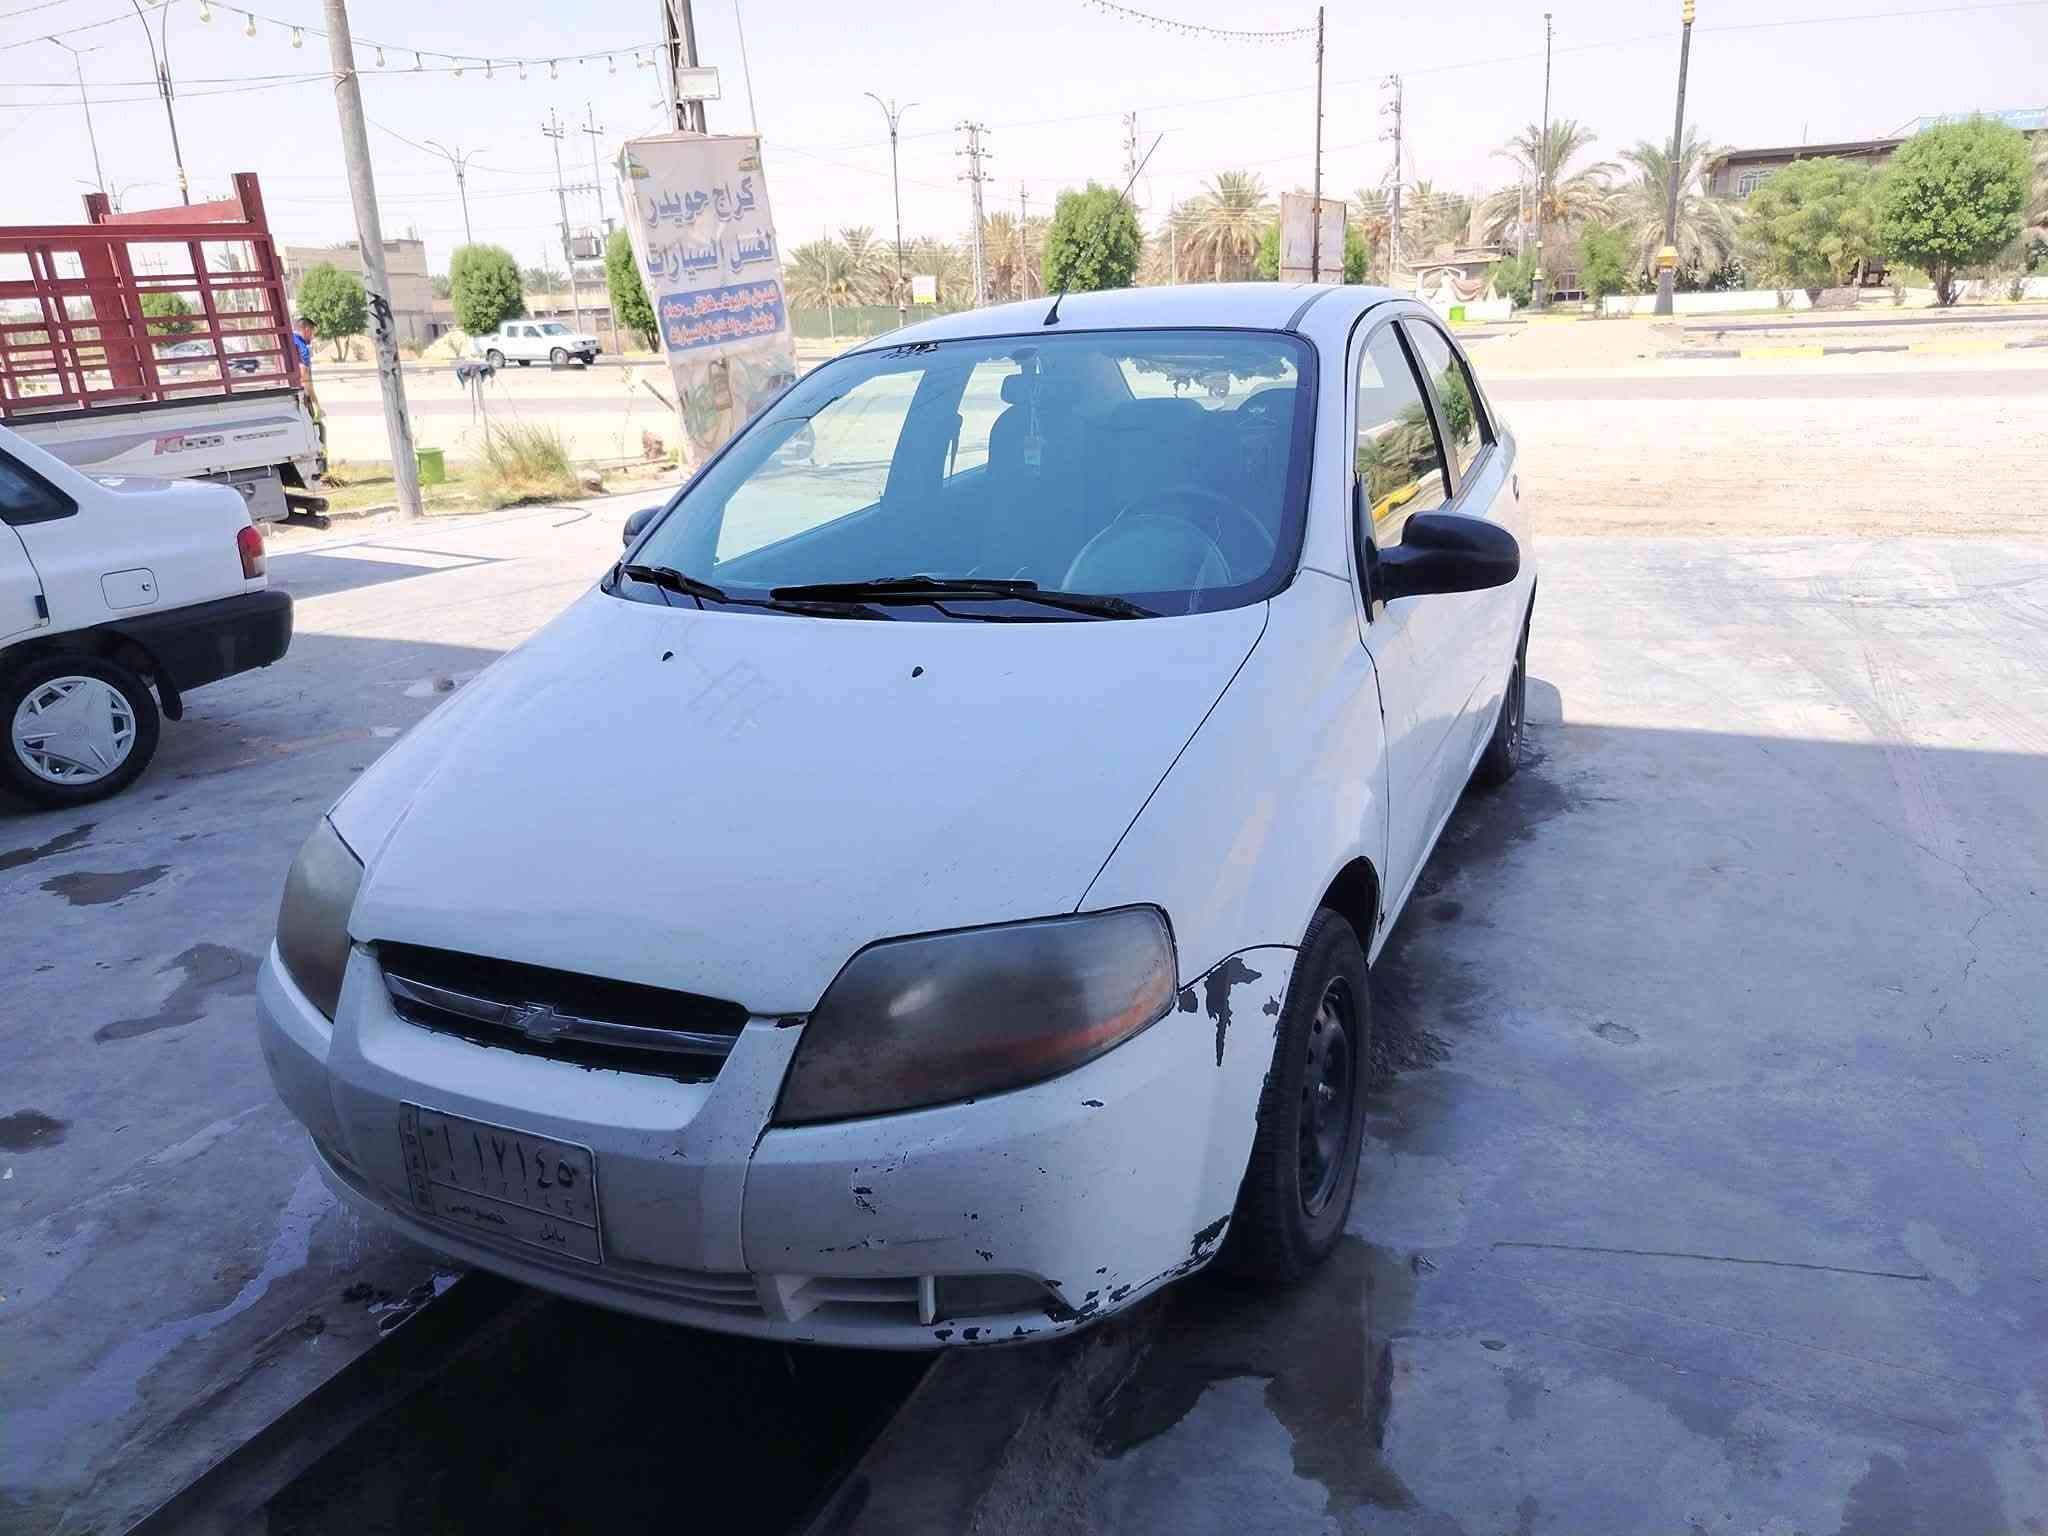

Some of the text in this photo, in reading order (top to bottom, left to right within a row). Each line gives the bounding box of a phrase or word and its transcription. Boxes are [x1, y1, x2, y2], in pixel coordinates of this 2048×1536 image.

[712, 175, 755, 221] كراج
[647, 227, 774, 280] لغسل السيارات
[447, 1202, 566, 1246] بابل خصوصي
